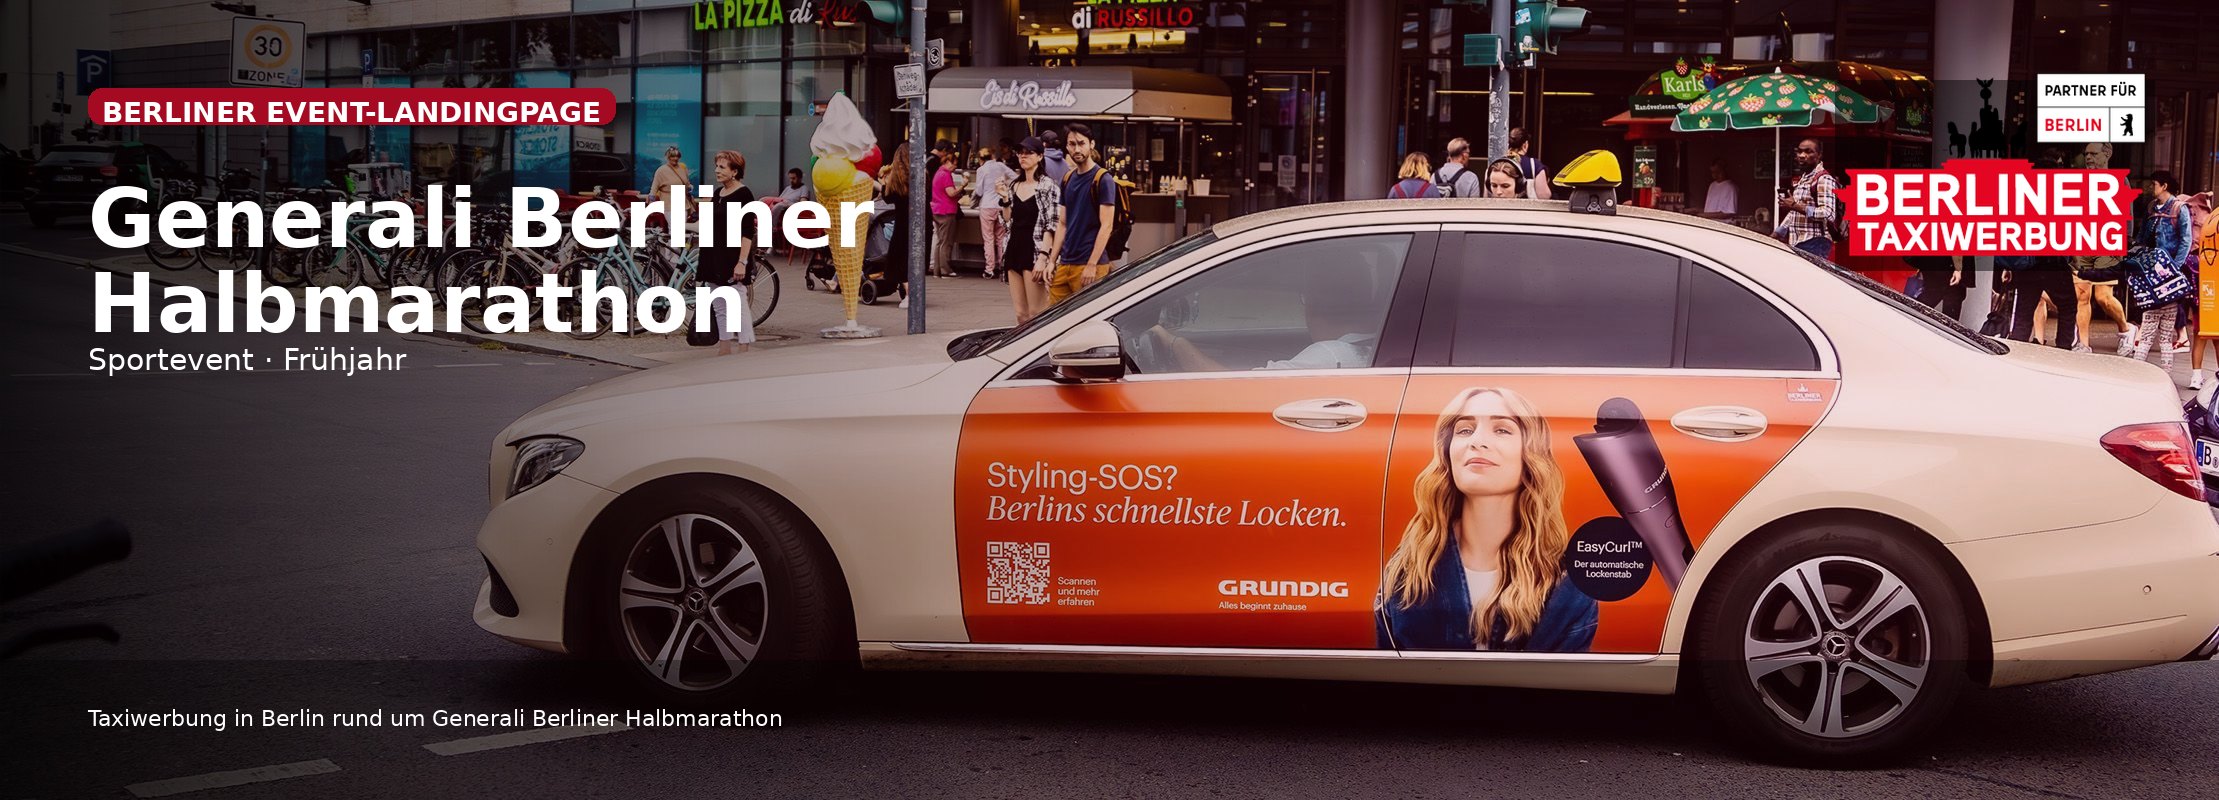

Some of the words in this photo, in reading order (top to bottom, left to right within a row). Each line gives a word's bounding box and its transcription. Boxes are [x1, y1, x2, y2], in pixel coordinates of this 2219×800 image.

[694, 2, 718, 30] LA
[723, 0, 784, 29] PIZZA
[789, 0, 813, 24] di
[1072, 6, 1091, 29] di
[1098, 7, 1193, 28] RUSSILLO
[254, 36, 282, 57] 30
[1664, 75, 1706, 93] Karls
[1019, 79, 1077, 109] Russillo
[987, 461, 1178, 495] Styling-SOS?
[986, 494, 1088, 523] Berlins
[1092, 496, 1232, 526] schnellste
[1237, 499, 1347, 527] Locken.
[1574, 560, 1589, 568] Der
[1589, 560, 1644, 569] automatische
[1057, 576, 1097, 586] Scannen
[1585, 569, 1632, 579] Lockenstab
[1057, 586, 1076, 596] und
[1076, 587, 1101, 597] mehr
[1218, 579, 1349, 598] GRUNDIG
[1057, 597, 1095, 607] erfahren
[1218, 601, 1239, 610] Alles
[1239, 601, 1271, 612] beginnt
[1273, 603, 1307, 611] zuhause
